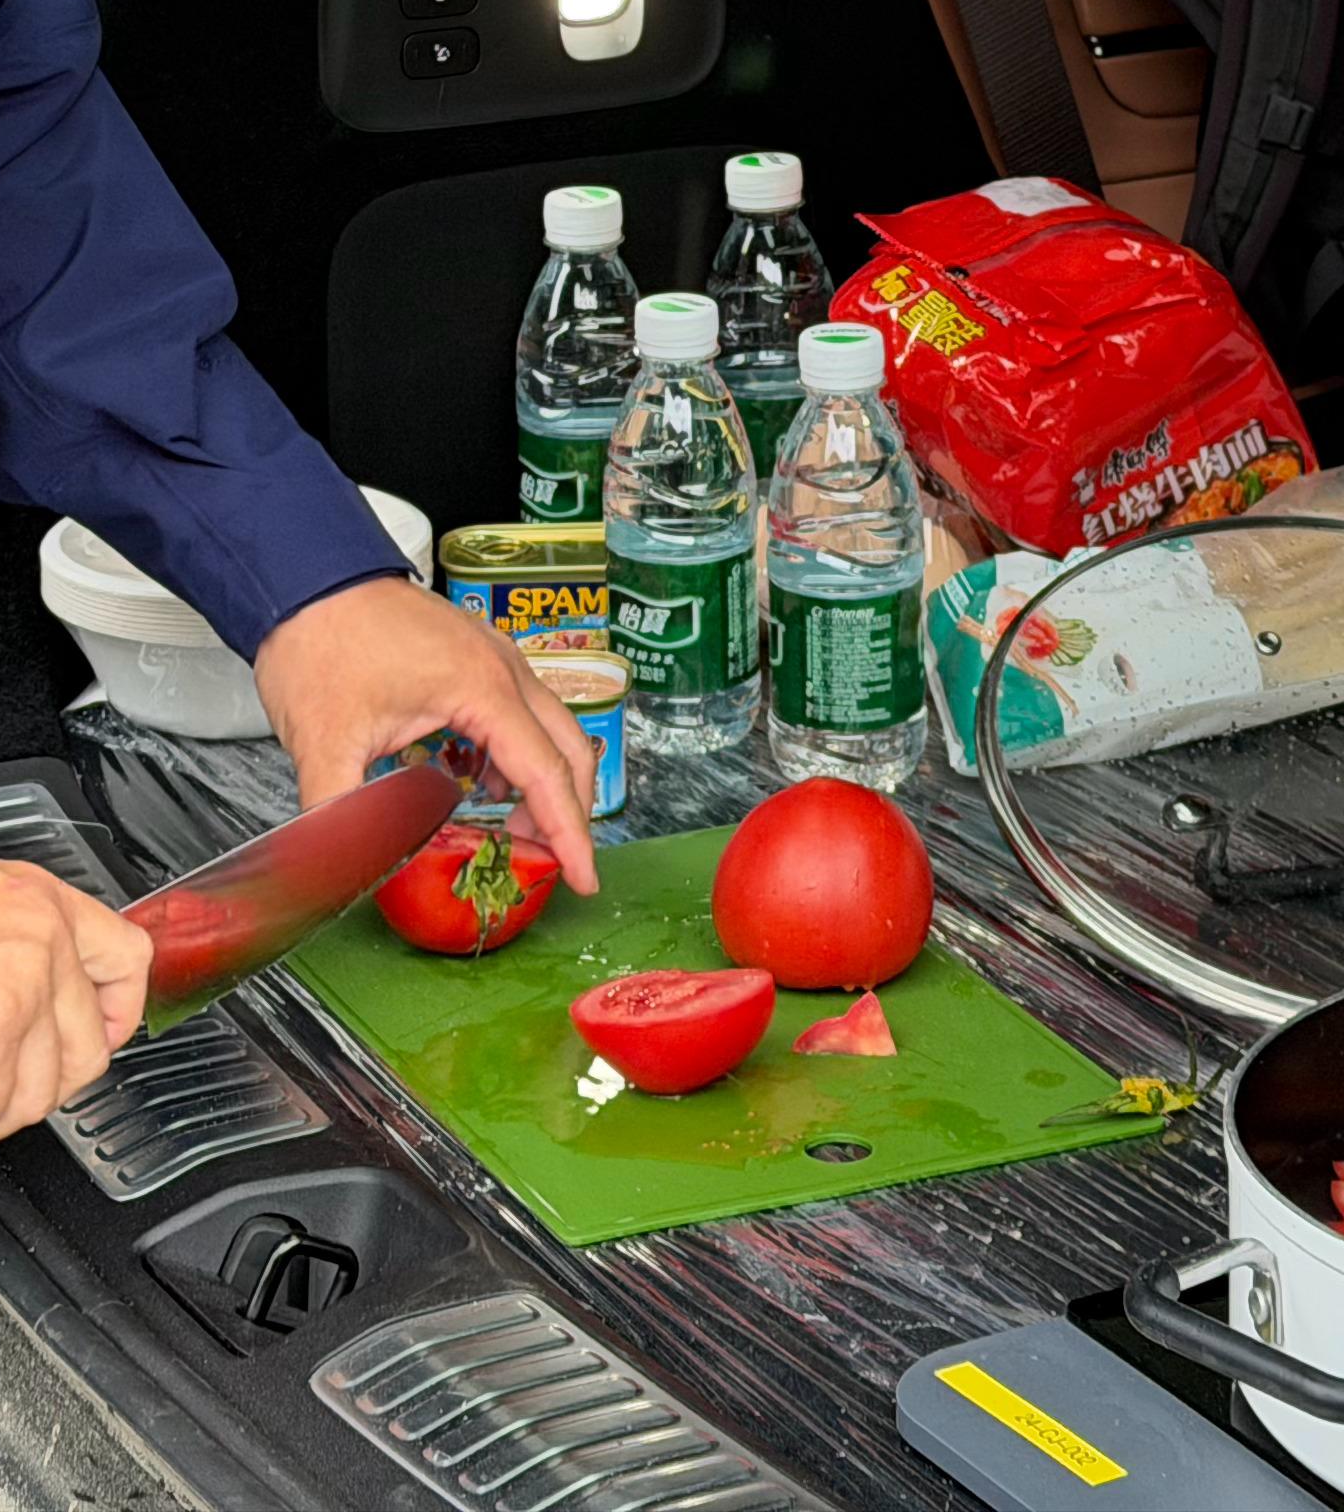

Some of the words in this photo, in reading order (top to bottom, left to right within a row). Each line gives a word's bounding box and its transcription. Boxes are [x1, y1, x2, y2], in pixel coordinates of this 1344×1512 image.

[1081, 418, 1268, 546] 红烧牛肉面
[507, 586, 607, 617] SPAM
